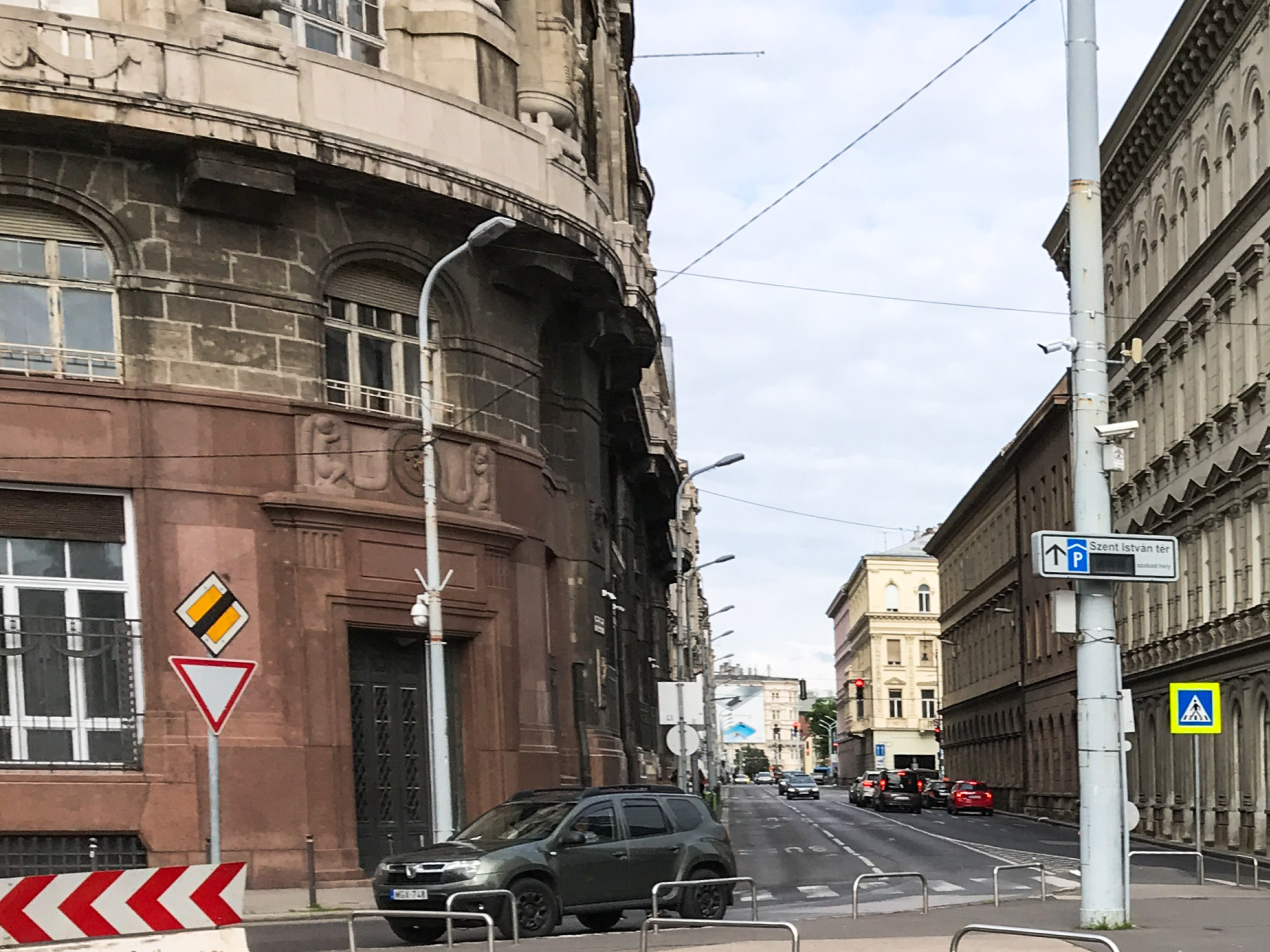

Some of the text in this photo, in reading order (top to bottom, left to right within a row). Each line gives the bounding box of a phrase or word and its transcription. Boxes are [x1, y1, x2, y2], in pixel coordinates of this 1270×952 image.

[1089, 541, 1170, 554] Szent István tér
[1073, 551, 1083, 568] P
